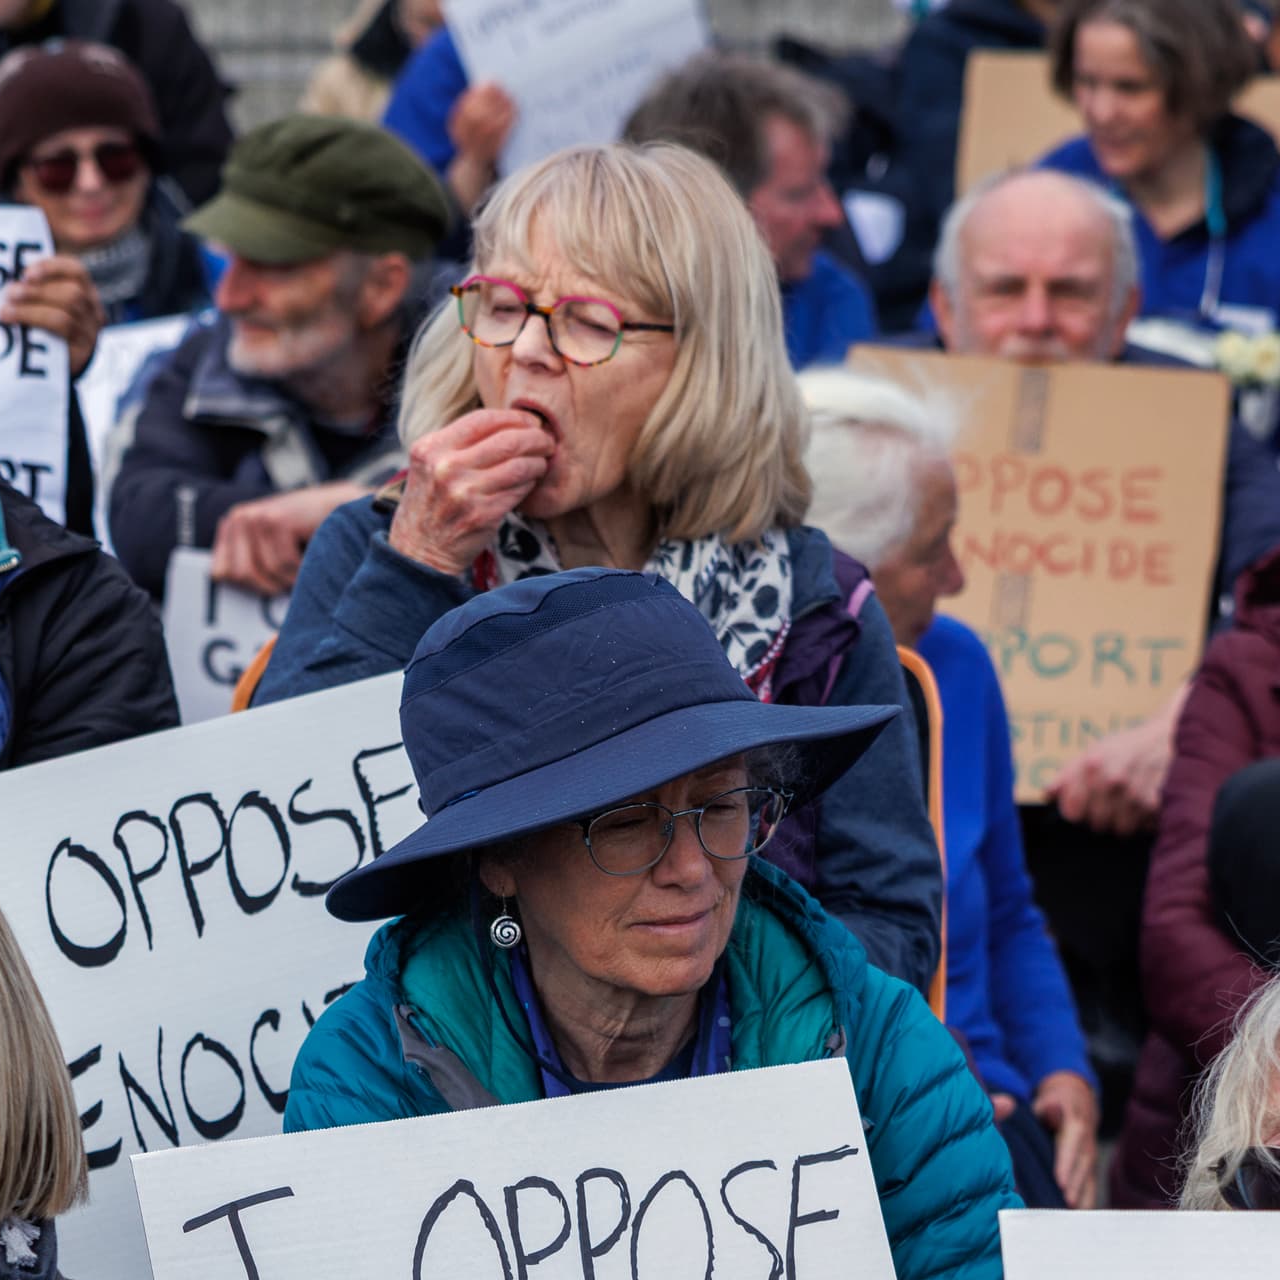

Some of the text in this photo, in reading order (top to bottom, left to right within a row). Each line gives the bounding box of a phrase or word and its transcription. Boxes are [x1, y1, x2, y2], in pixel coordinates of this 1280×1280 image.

[956, 452, 1165, 524] PPOSE
[963, 528, 1176, 586] NOCIDE
[984, 624, 1185, 687] PORT
[45, 740, 414, 967] OPPOSE
